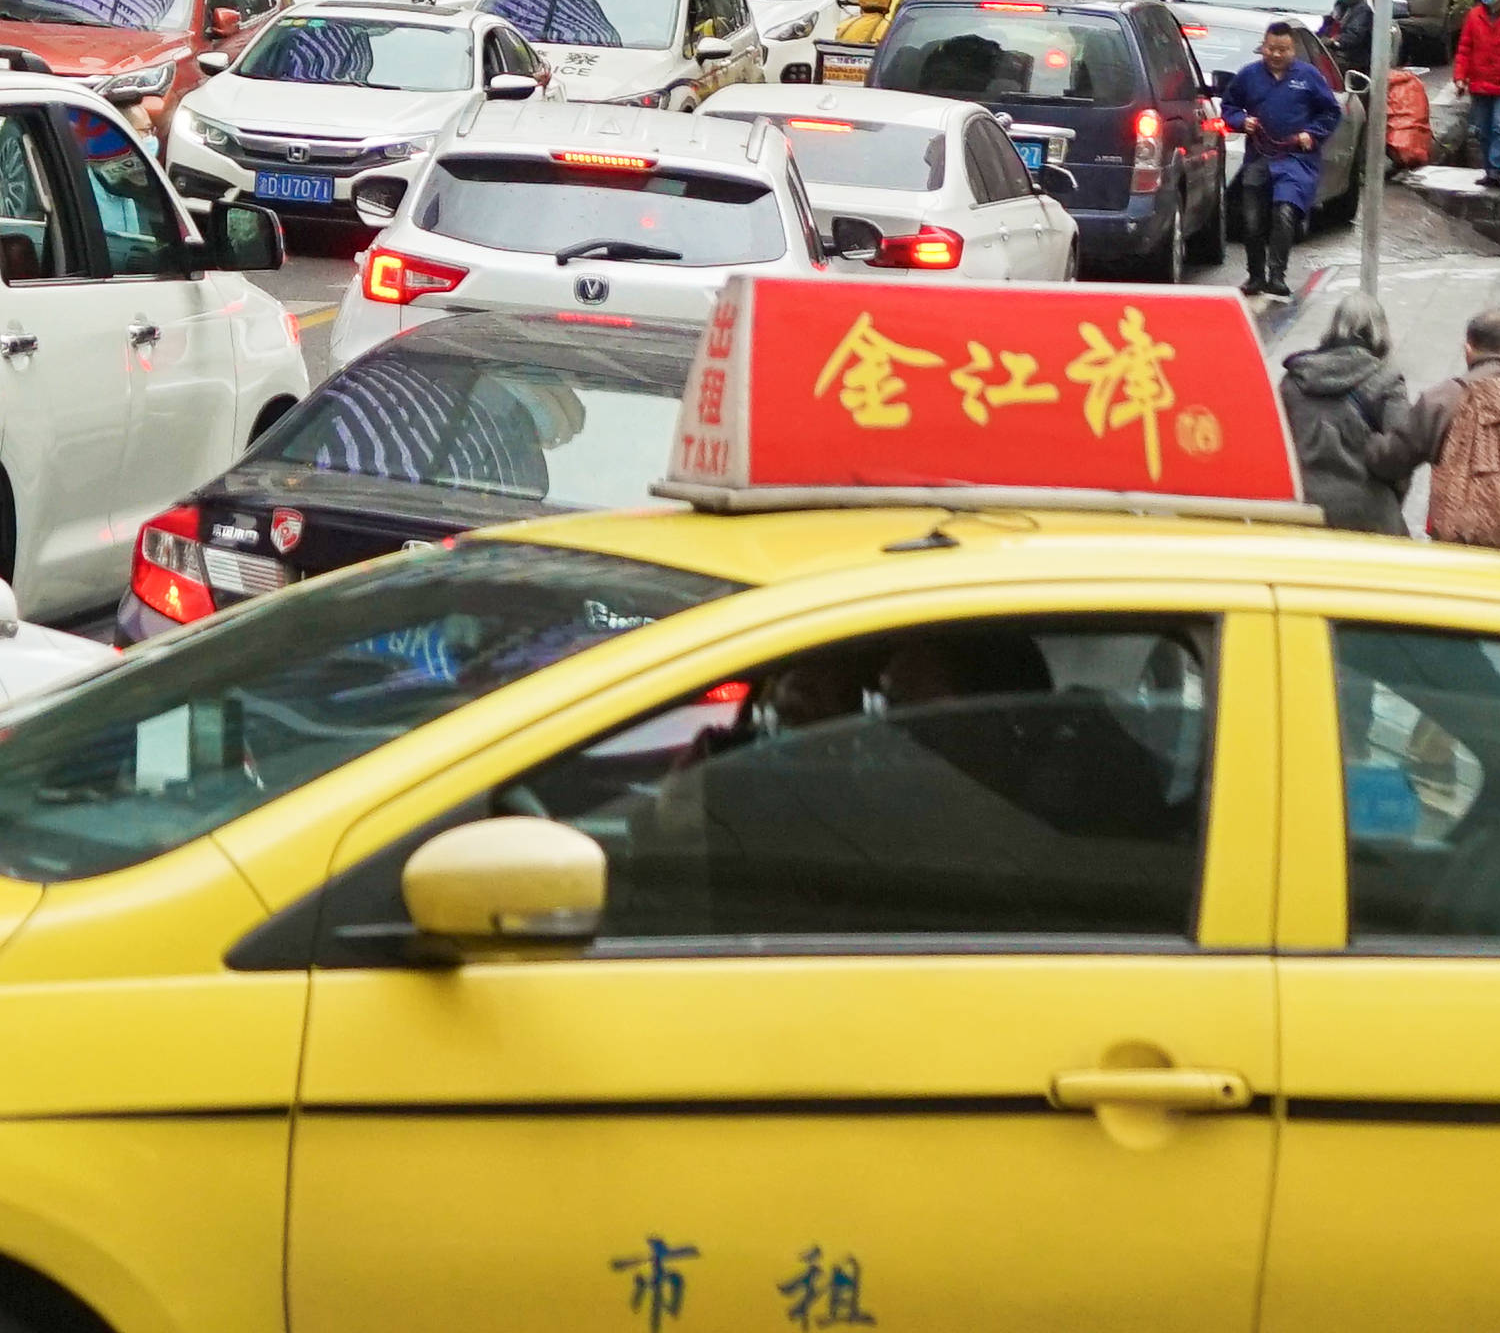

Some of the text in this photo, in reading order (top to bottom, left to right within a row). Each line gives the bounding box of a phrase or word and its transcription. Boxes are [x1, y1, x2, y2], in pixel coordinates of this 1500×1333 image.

[553, 65, 592, 77] ICE
[705, 301, 738, 426] 出租
[676, 435, 729, 476] TAXI
